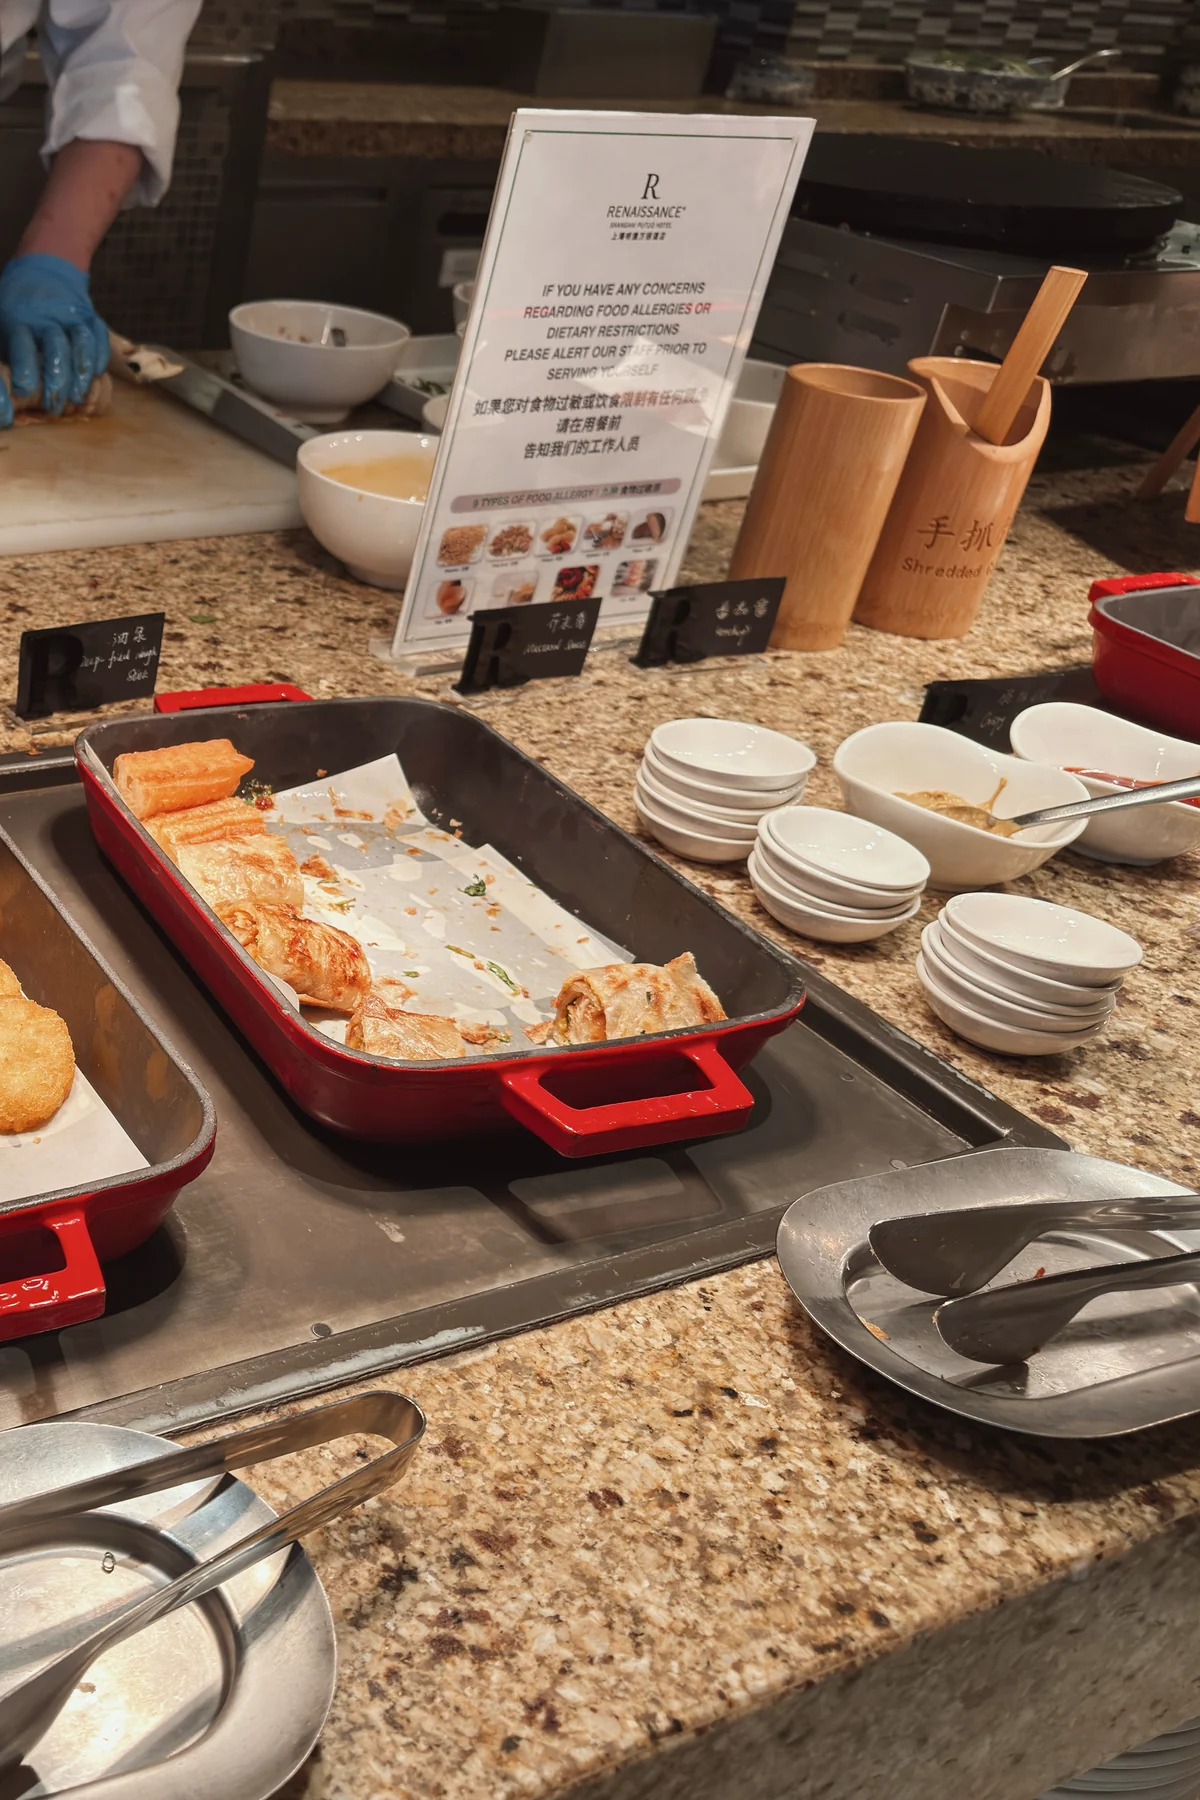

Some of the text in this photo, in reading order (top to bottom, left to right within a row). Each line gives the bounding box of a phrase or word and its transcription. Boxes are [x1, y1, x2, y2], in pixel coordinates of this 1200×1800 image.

[640, 173, 661, 200] R
[606, 205, 682, 218] RENAISSANCE
[542, 282, 705, 297] IF YOU HAVE ANY CONCERNS
[523, 303, 712, 318] REGARDING FOOD ALLERGIES OR
[546, 323, 679, 339] DIETARY RESTRICTIONS
[504, 348, 550, 361] PLEASE
[551, 347, 590, 360] ALERT
[592, 346, 616, 358] OUR
[656, 343, 689, 355] PRIOR
[693, 342, 707, 354] TO
[546, 366, 597, 380] SERVING
[556, 415, 622, 434] 请在用餐前
[523, 436, 640, 459] 告知我们的工作人员
[902, 557, 982, 580] Shredded
